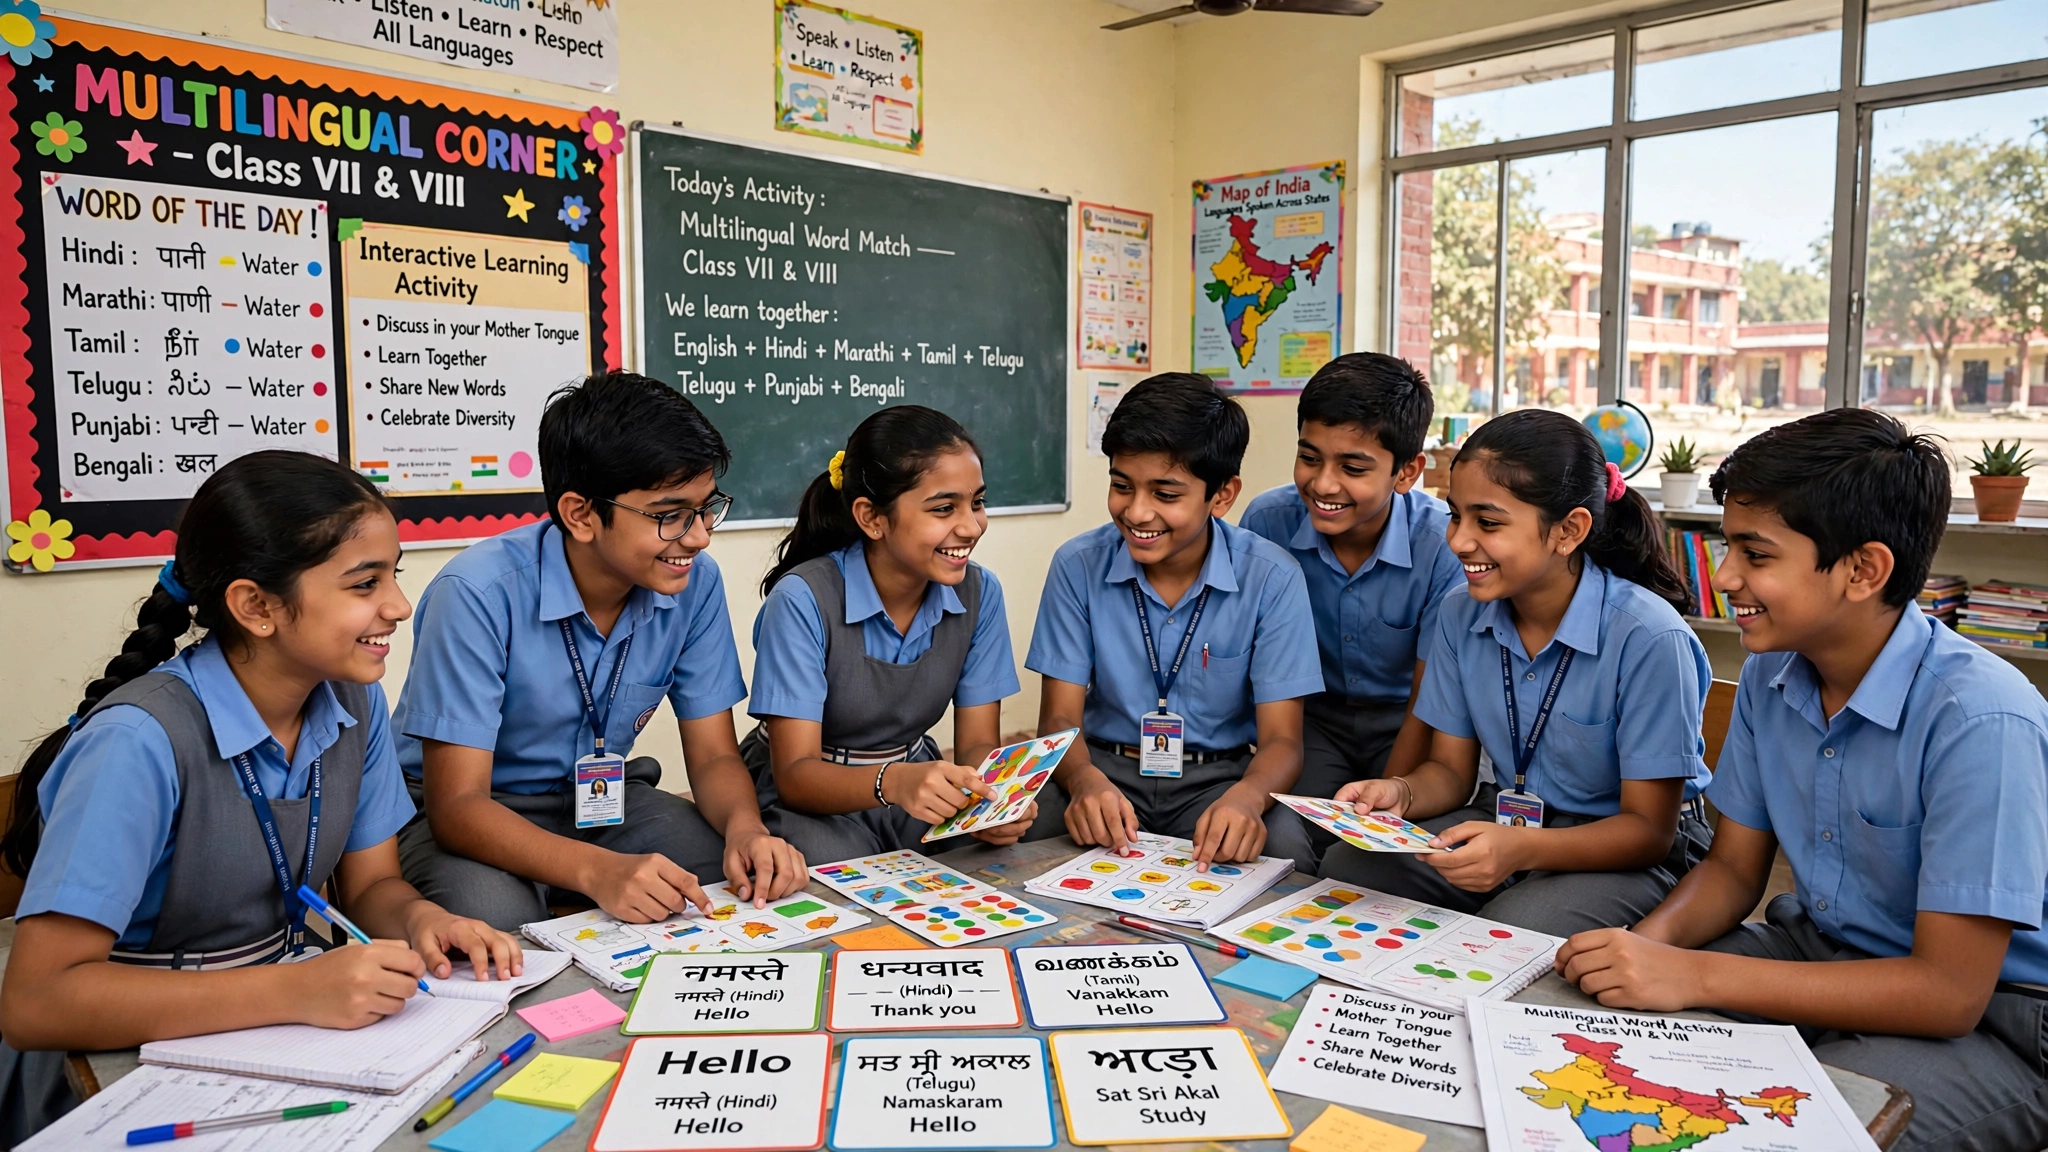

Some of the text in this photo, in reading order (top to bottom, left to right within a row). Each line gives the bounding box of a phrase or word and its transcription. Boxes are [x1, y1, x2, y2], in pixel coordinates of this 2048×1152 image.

[371, 0, 604, 58] Listen Learn Respect
[373, 18, 514, 67] All Languages
[796, 23, 894, 63] Speak Listen
[802, 50, 835, 75] Learn
[75, 63, 579, 181] MULTILINGUAL CORNER
[206, 141, 302, 188] Class
[311, 155, 361, 196] VII
[374, 165, 400, 200] &
[410, 169, 466, 208] VIII
[663, 166, 735, 205] Today's
[743, 176, 815, 215] Activity
[1220, 175, 1311, 205] Map of India
[1275, 198, 1303, 209] Across
[1304, 193, 1331, 206] States
[55, 186, 142, 221] WORD
[152, 195, 186, 224] OF
[195, 199, 246, 230] THE
[257, 205, 304, 236] DAY
[680, 210, 911, 257] Multilingual Word Match
[61, 236, 124, 265] Hindi
[156, 241, 206, 270] पानी
[242, 251, 299, 276] Water
[359, 236, 569, 284] Interactive Learning
[682, 248, 838, 285] Class VII & VIII
[161, 285, 212, 313] पाणी
[244, 294, 301, 318] Water
[394, 271, 479, 306] Activity
[665, 292, 696, 318] We
[704, 294, 749, 320] learn
[757, 299, 829, 330] together
[64, 328, 125, 353] Tamil
[246, 337, 303, 359] Water
[376, 314, 580, 345] Discuss in your Mother Tongue
[378, 345, 487, 371] Learn Together
[674, 331, 1024, 376] English + Hindi + Marathi + Tamil + Telugu
[67, 370, 141, 402] Telugu
[248, 376, 305, 398] Water
[380, 376, 507, 397] Share New Words
[677, 370, 905, 406] Telugu + Punjabi + Bengali
[71, 411, 151, 443] Punjabi
[250, 415, 307, 436] Water
[380, 407, 516, 431] Celebrate Diversity
[74, 452, 153, 483] Bengali
[681, 958, 790, 983] नमस्ते
[860, 960, 985, 978] धन्यवाद
[1034, 950, 1180, 972] வணக்கம்
[674, 987, 785, 1004] नमस्ते (Hindi)
[899, 984, 954, 999] (Hindi)
[1066, 987, 1170, 1001] Vanakkam
[1083, 974, 1140, 988] (Tamil)
[693, 1007, 750, 1021] Hello
[870, 1003, 977, 1019] Thank you
[1096, 1003, 1154, 1017] Hello
[1334, 1007, 1453, 1038] Mother Tongue
[1342, 993, 1456, 1022] Discuss in your
[1524, 1006, 1620, 1026] Multilingual
[1672, 1021, 1734, 1038] Activity
[1328, 1022, 1442, 1053] Learn Together
[1575, 1022, 1691, 1043] Class VII & VIII
[657, 1048, 792, 1076] Hello
[857, 1055, 902, 1072] ਸਤ
[950, 1054, 1032, 1071] ਅਕਾਲ
[1321, 1039, 1458, 1076] Share New Words
[905, 1076, 976, 1093] (Telugu)
[1312, 1056, 1463, 1098] Celebrate Diversity
[654, 1091, 778, 1112] नमस्ते (Hindi)
[882, 1094, 1004, 1109] Namaskaram
[1096, 1084, 1221, 1103] Sat Sri Akal
[673, 1117, 744, 1135] Hello
[909, 1115, 978, 1133] Hello
[1139, 1106, 1207, 1126] Study
